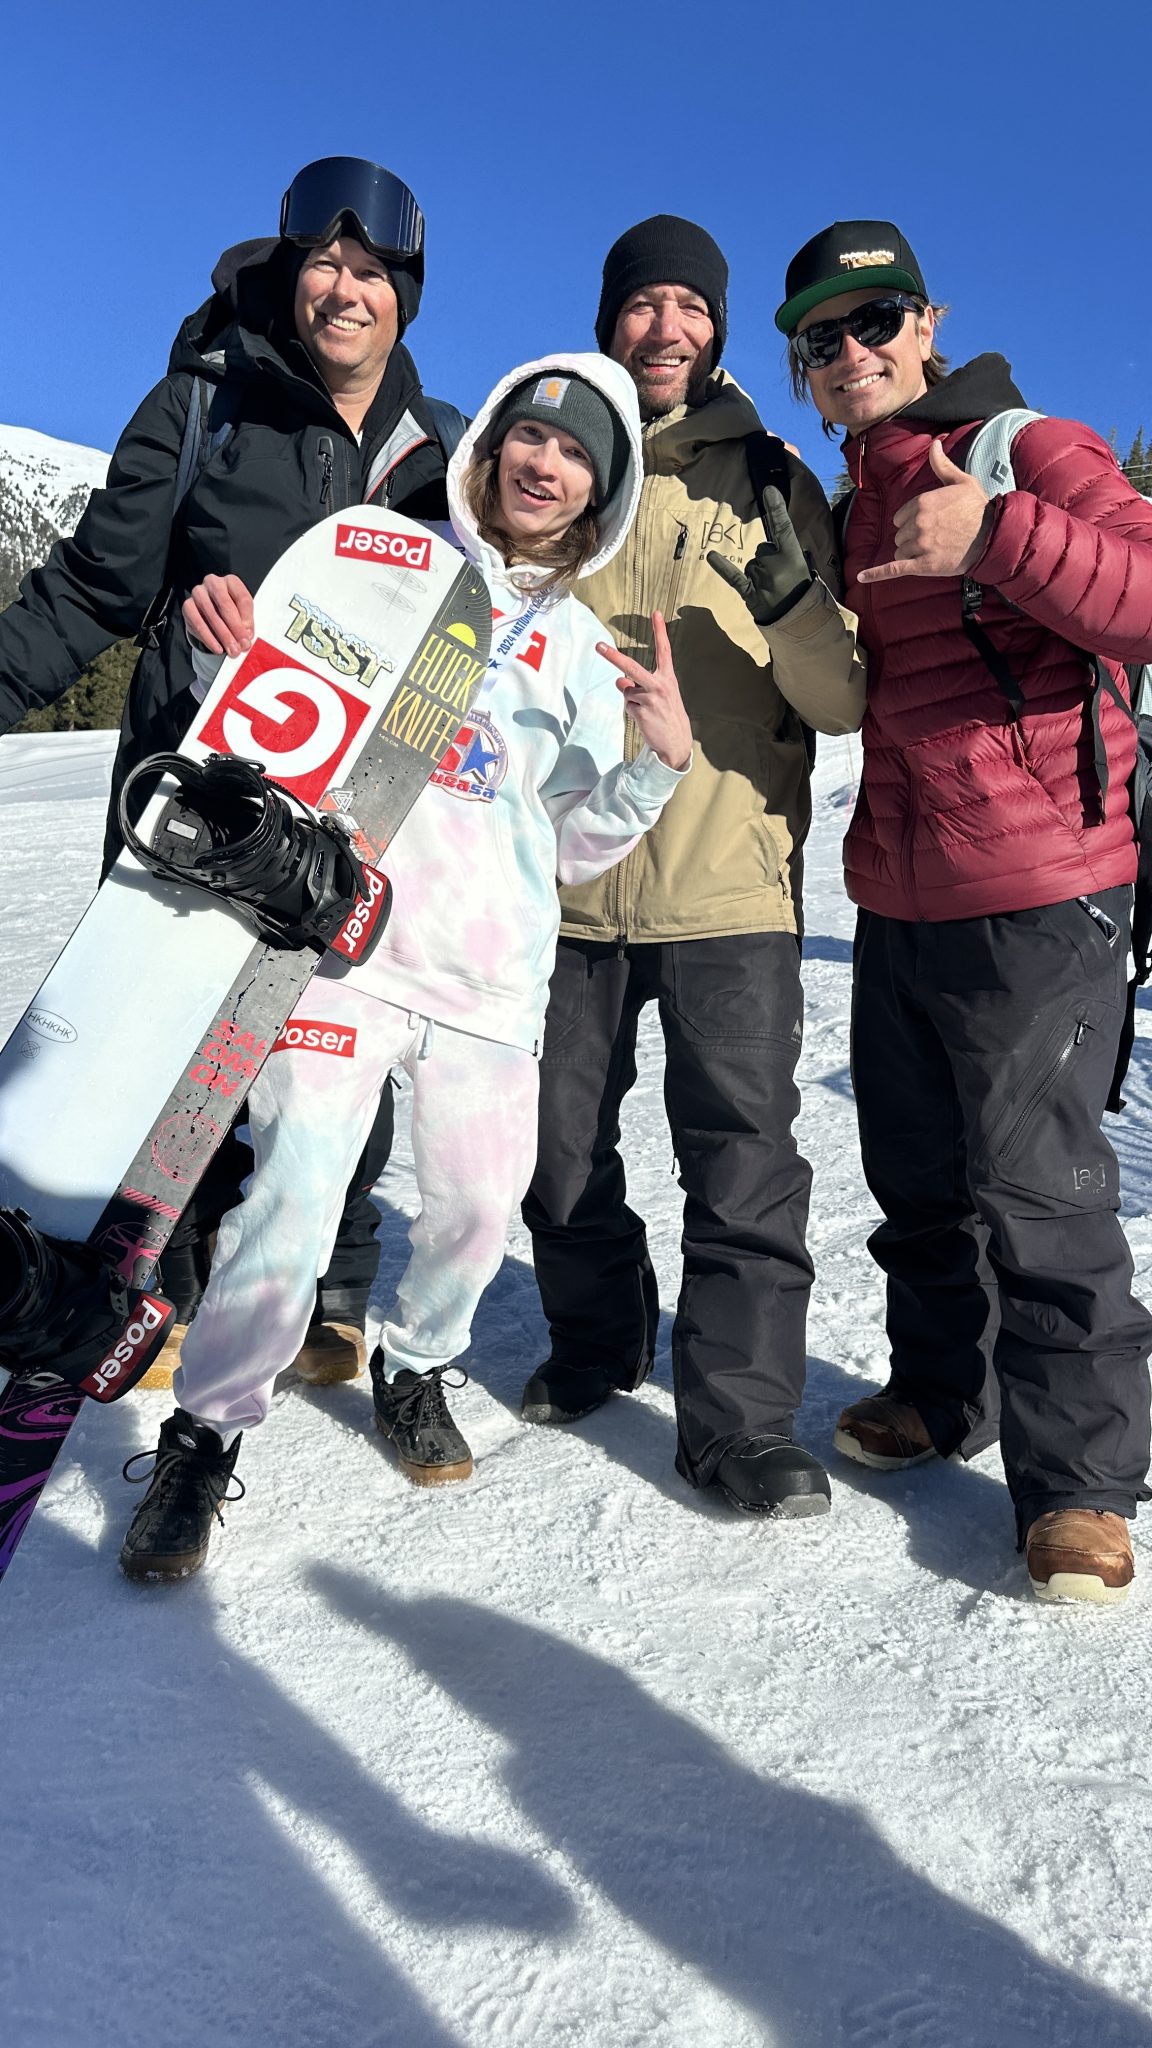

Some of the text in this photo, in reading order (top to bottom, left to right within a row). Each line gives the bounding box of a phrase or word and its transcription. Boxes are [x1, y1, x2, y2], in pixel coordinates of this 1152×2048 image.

[340, 529, 428, 566] Poser
[699, 554, 743, 564] BON
[497, 634, 517, 655] 2024
[511, 603, 537, 636] NATIONAL
[408, 633, 488, 713] HUCK
[382, 685, 461, 763] KNIFE
[28, 1011, 72, 1039] HKHKHK
[213, 1019, 268, 1059] SAL
[277, 1025, 353, 1053] oser
[202, 1041, 259, 1079] OM
[189, 1063, 240, 1098] ON
[92, 1299, 163, 1394] Poser
